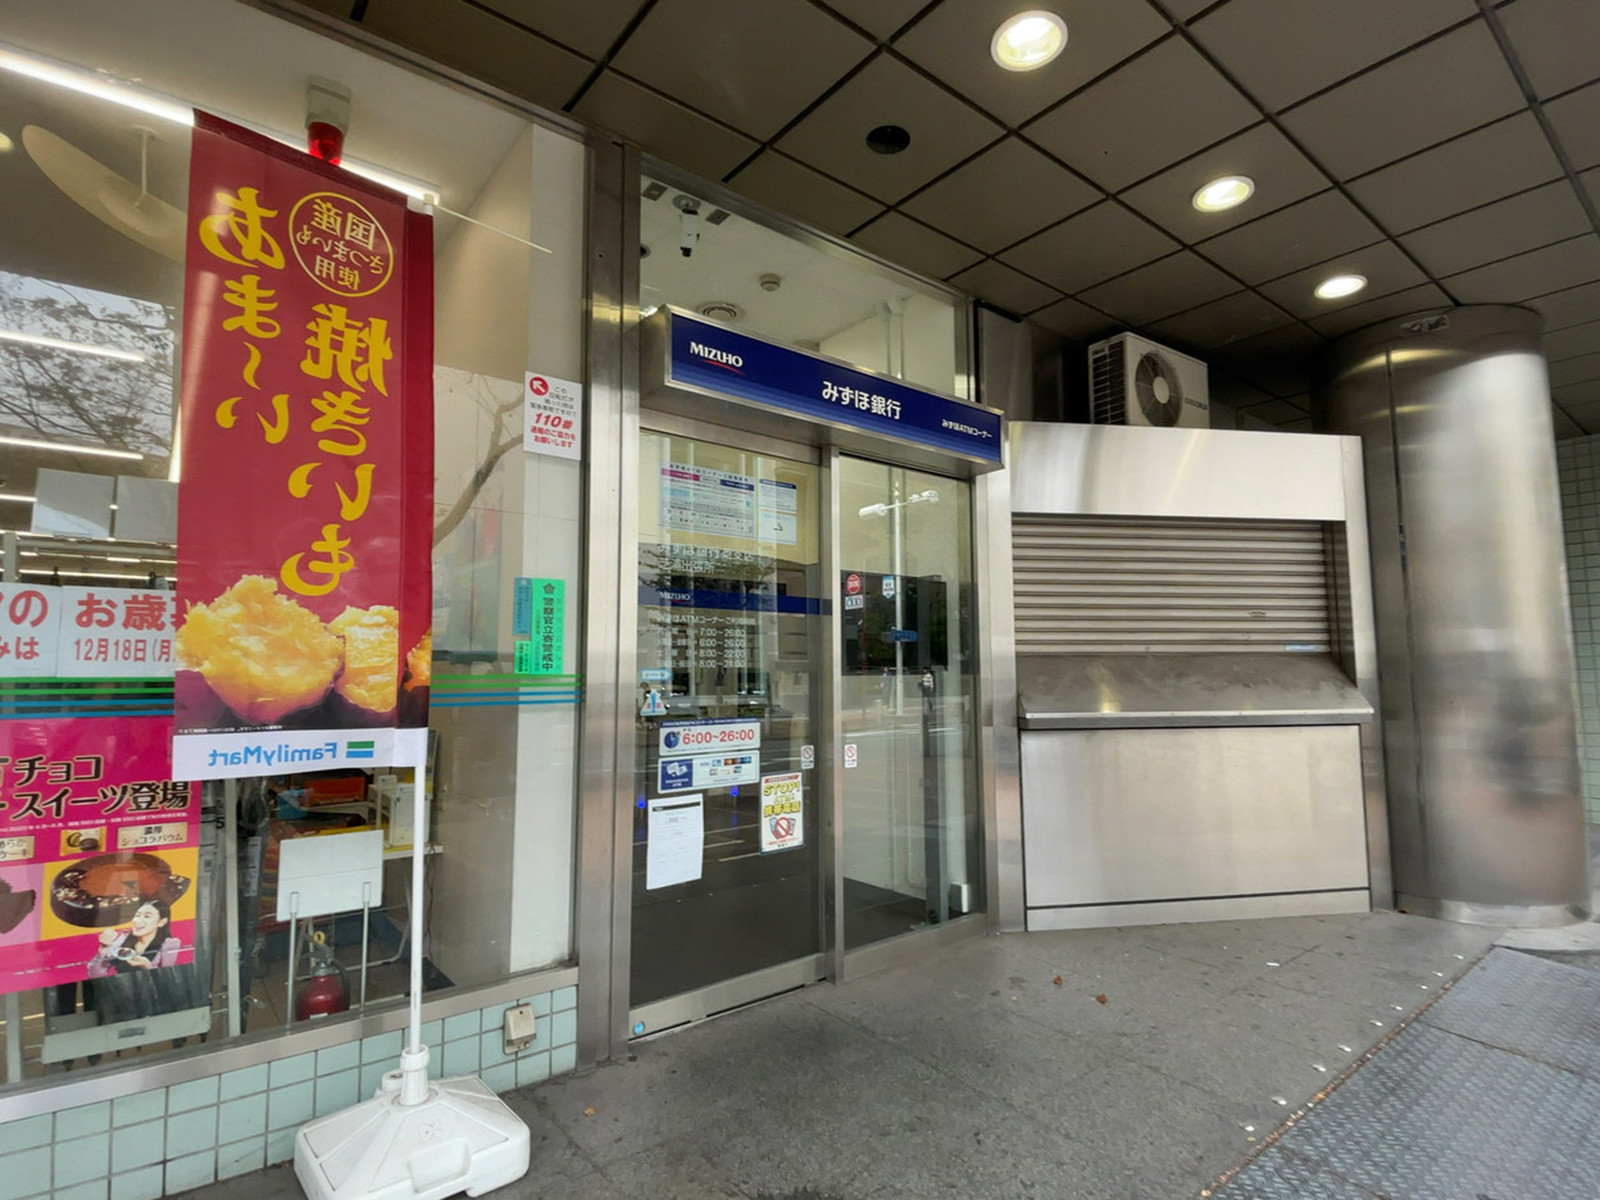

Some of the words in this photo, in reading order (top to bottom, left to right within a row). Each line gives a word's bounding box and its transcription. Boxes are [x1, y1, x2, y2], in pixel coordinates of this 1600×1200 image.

[689, 341, 743, 368] MIZUHO
[822, 380, 902, 421] みずほ銀行
[535, 412, 574, 430] 110番
[941, 418, 993, 438] みずほATMコーナー
[0, 588, 48, 628] の
[659, 590, 691, 601] MIZUHO
[75, 637, 176, 662] 12月18日(月
[0, 754, 104, 788] チョコ
